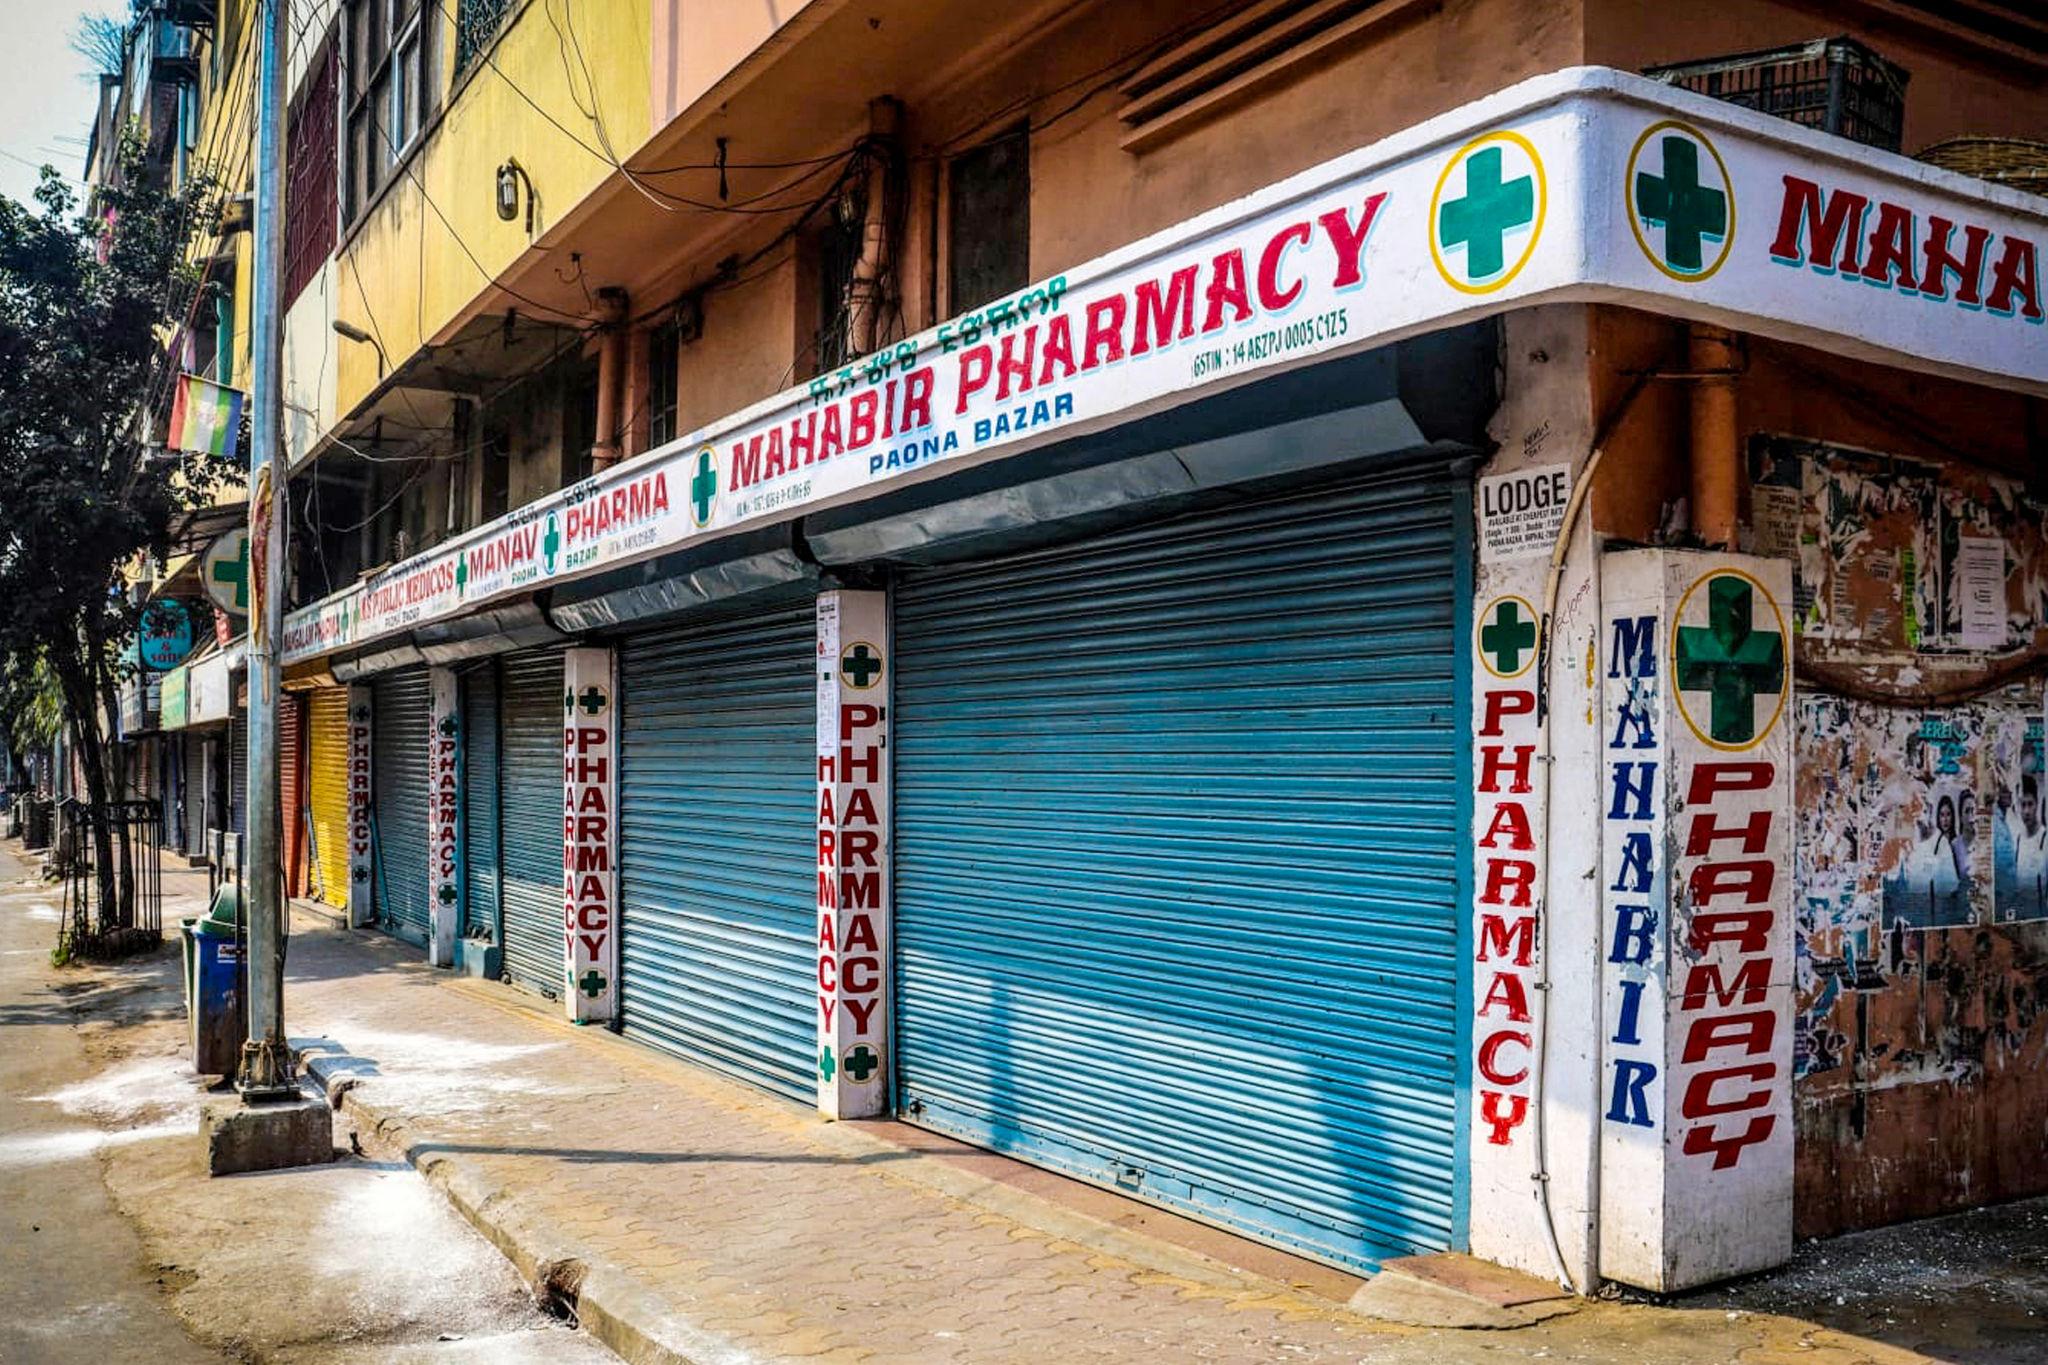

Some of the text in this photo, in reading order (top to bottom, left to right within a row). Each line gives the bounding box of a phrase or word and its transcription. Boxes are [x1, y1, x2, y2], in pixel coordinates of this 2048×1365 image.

[729, 190, 1388, 493] MAHABIR PHARMACY
[1769, 174, 2046, 322] MAHA
[469, 523, 539, 583] MANAV
[566, 471, 670, 546] PHARMA
[868, 391, 1074, 475] PAONA BAZAR
[1484, 471, 1567, 518] LODGE
[566, 545, 599, 570] BAZAR
[353, 726, 369, 857] PHARMACY
[440, 740, 457, 878] PHARMACY
[564, 727, 575, 961] PHARMACY
[577, 727, 608, 962] PHARMACY
[818, 755, 836, 1034] HARMACY
[840, 703, 880, 1035] PHARMACY
[1605, 613, 1660, 1129] MAHABIR
[1476, 688, 1537, 1147] PHARMACY
[1680, 761, 1778, 1171] PHARMACY
